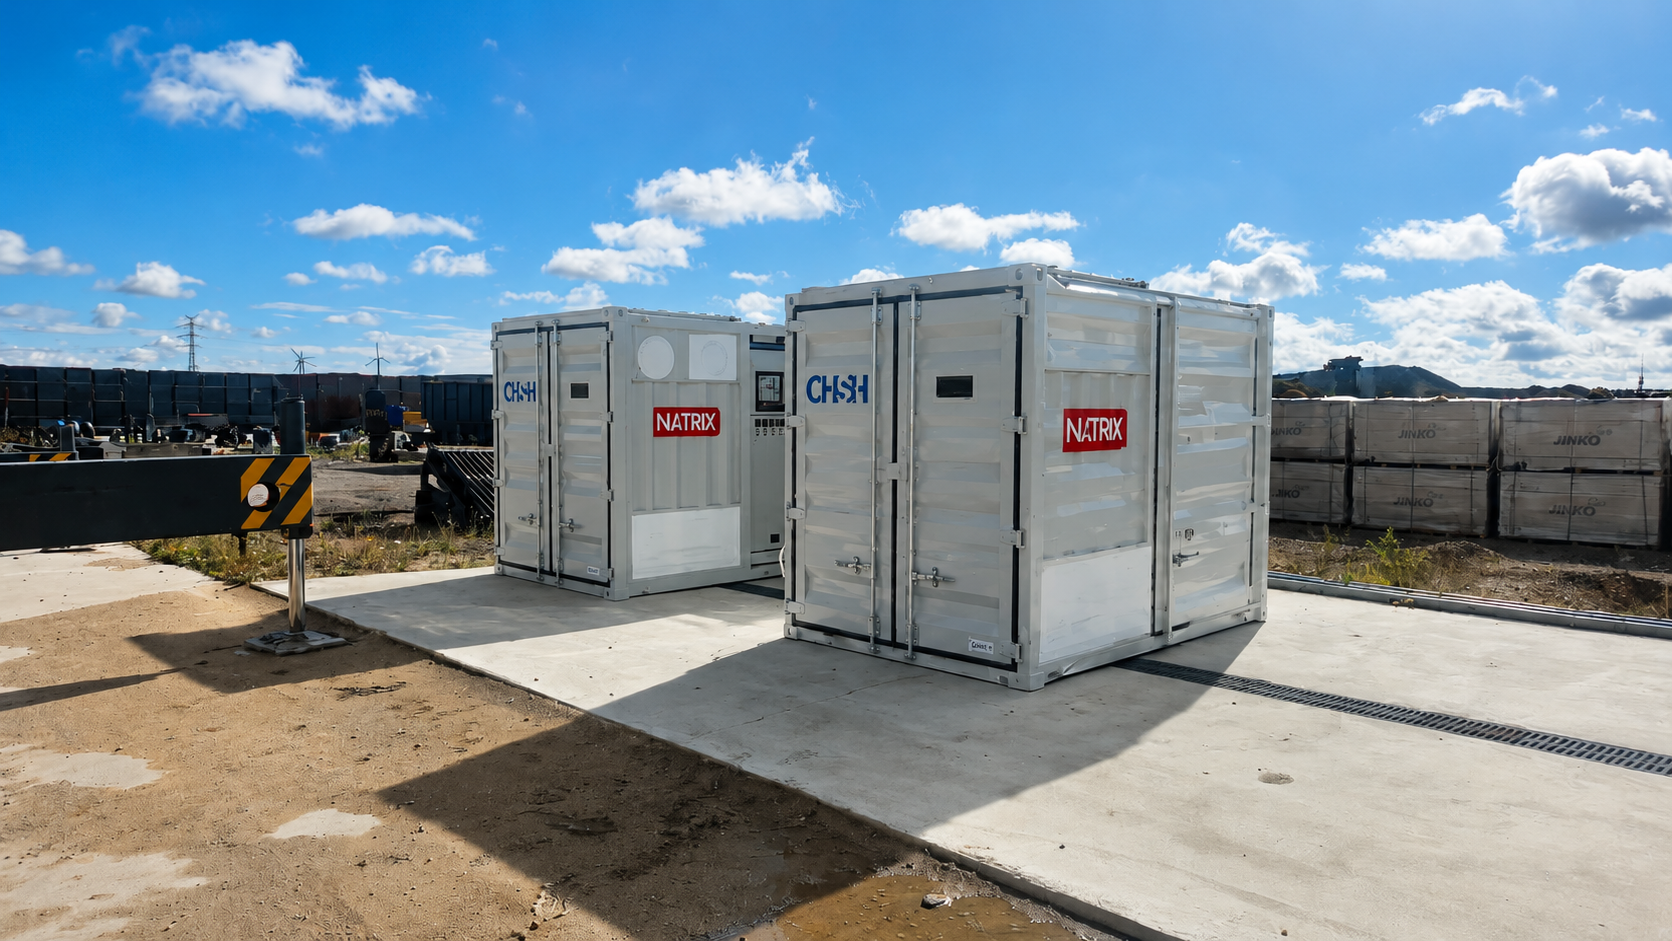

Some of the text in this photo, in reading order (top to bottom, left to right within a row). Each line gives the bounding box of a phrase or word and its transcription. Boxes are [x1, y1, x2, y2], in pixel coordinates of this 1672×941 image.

[657, 413, 716, 431] NATRIX
[1066, 417, 1123, 443] NATRIX
[1398, 429, 1436, 439] JINKO
[1553, 435, 1601, 446] JINKO
[1393, 497, 1434, 507] JINKO
